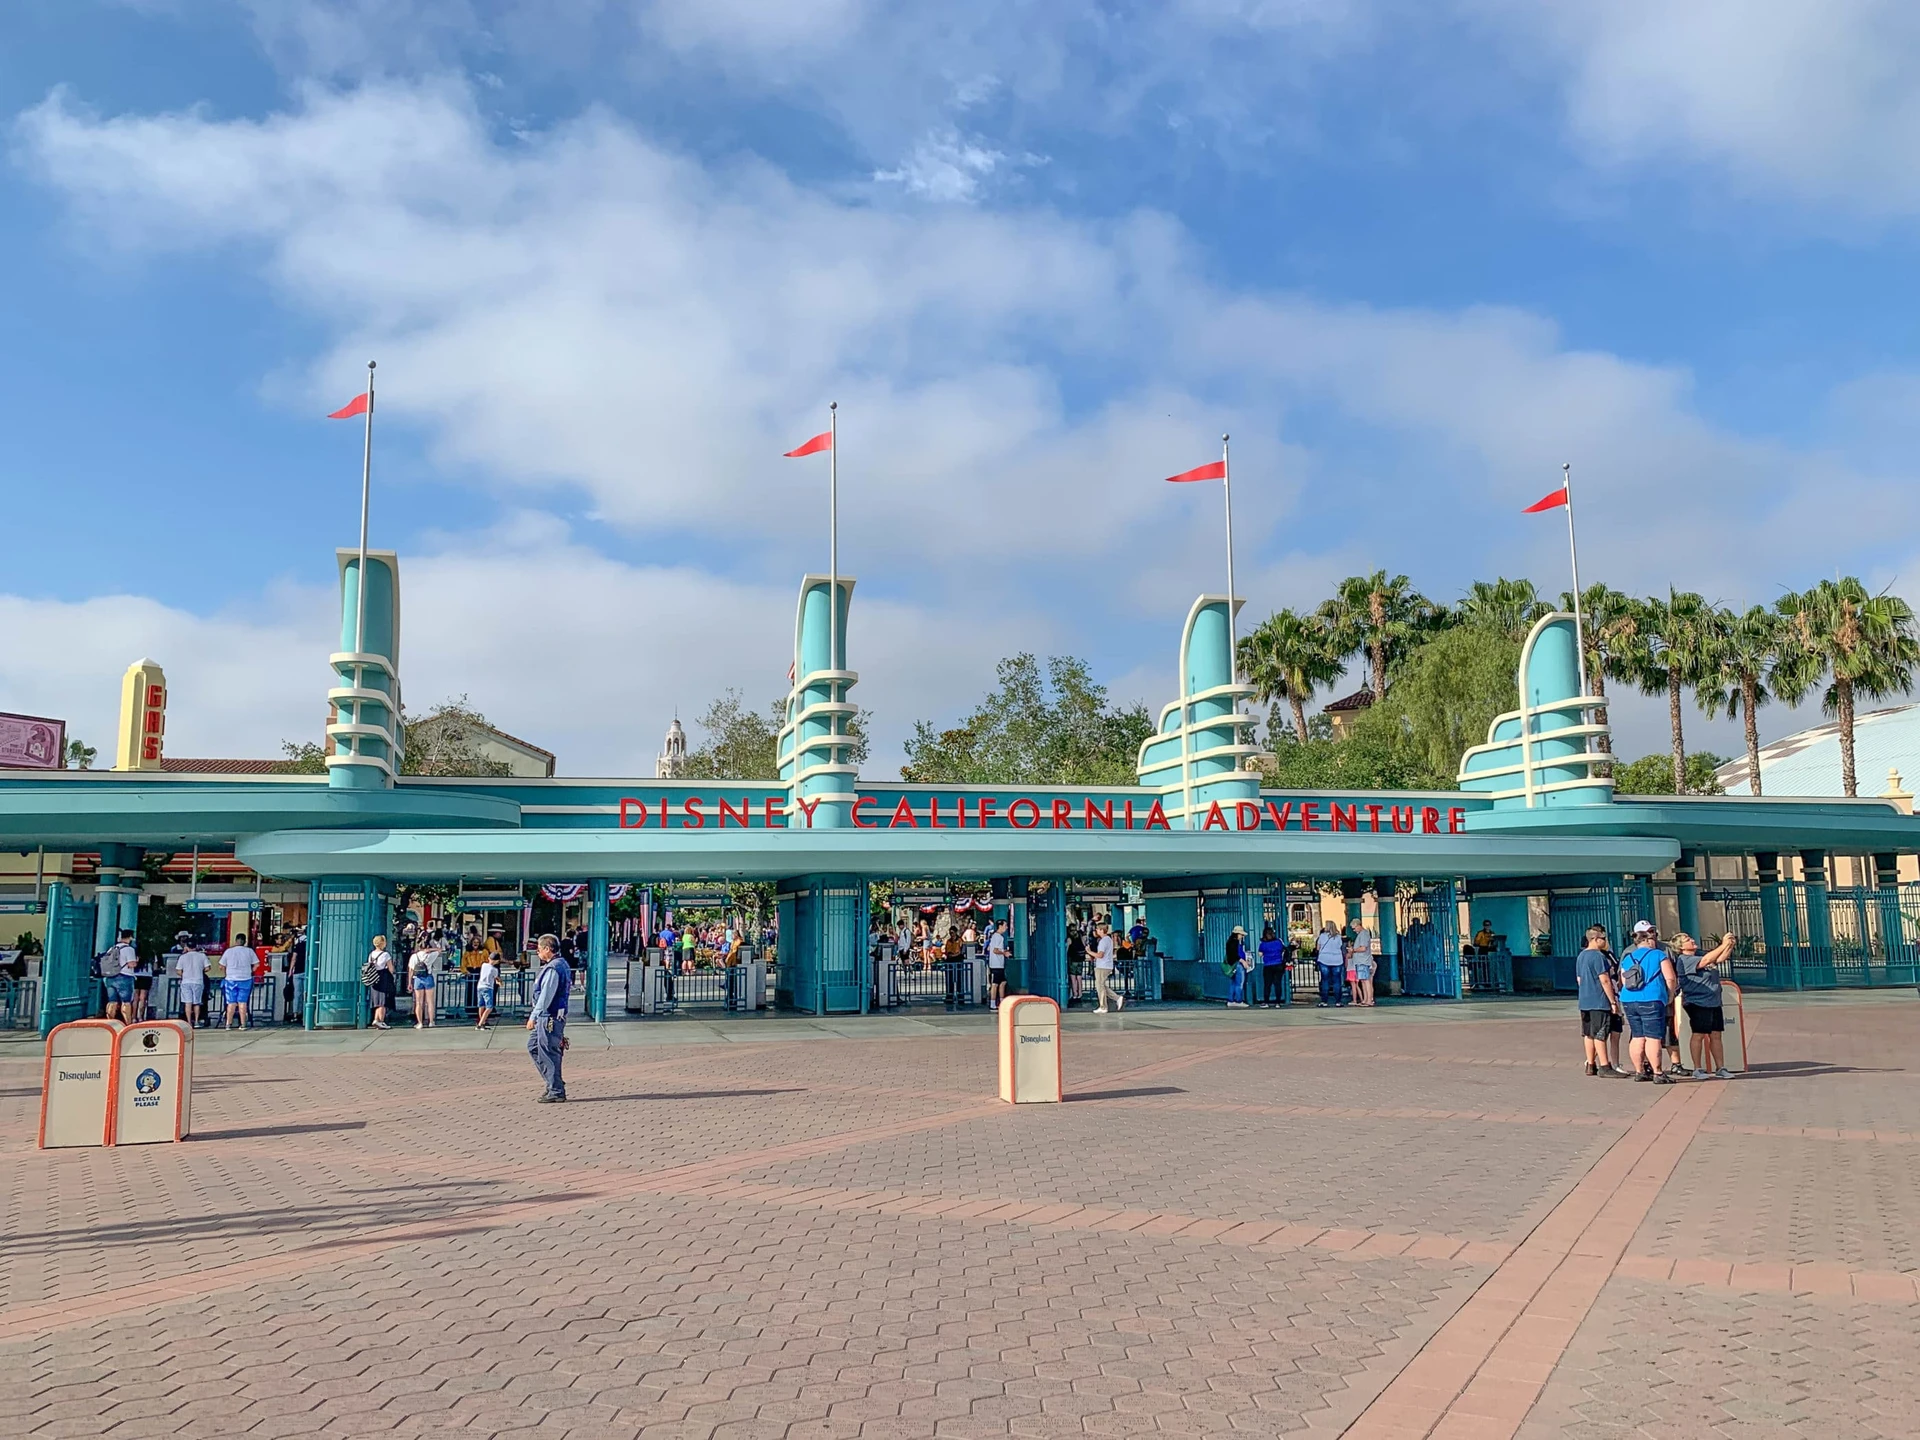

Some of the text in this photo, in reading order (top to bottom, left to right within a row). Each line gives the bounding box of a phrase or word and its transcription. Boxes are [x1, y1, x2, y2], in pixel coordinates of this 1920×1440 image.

[143, 685, 162, 759] GAS
[619, 795, 1467, 834] DISNEY CALIFORNIA ADVENTURE
[1019, 1034, 1051, 1043] Disneyland
[58, 1070, 101, 1081] Disneyland
